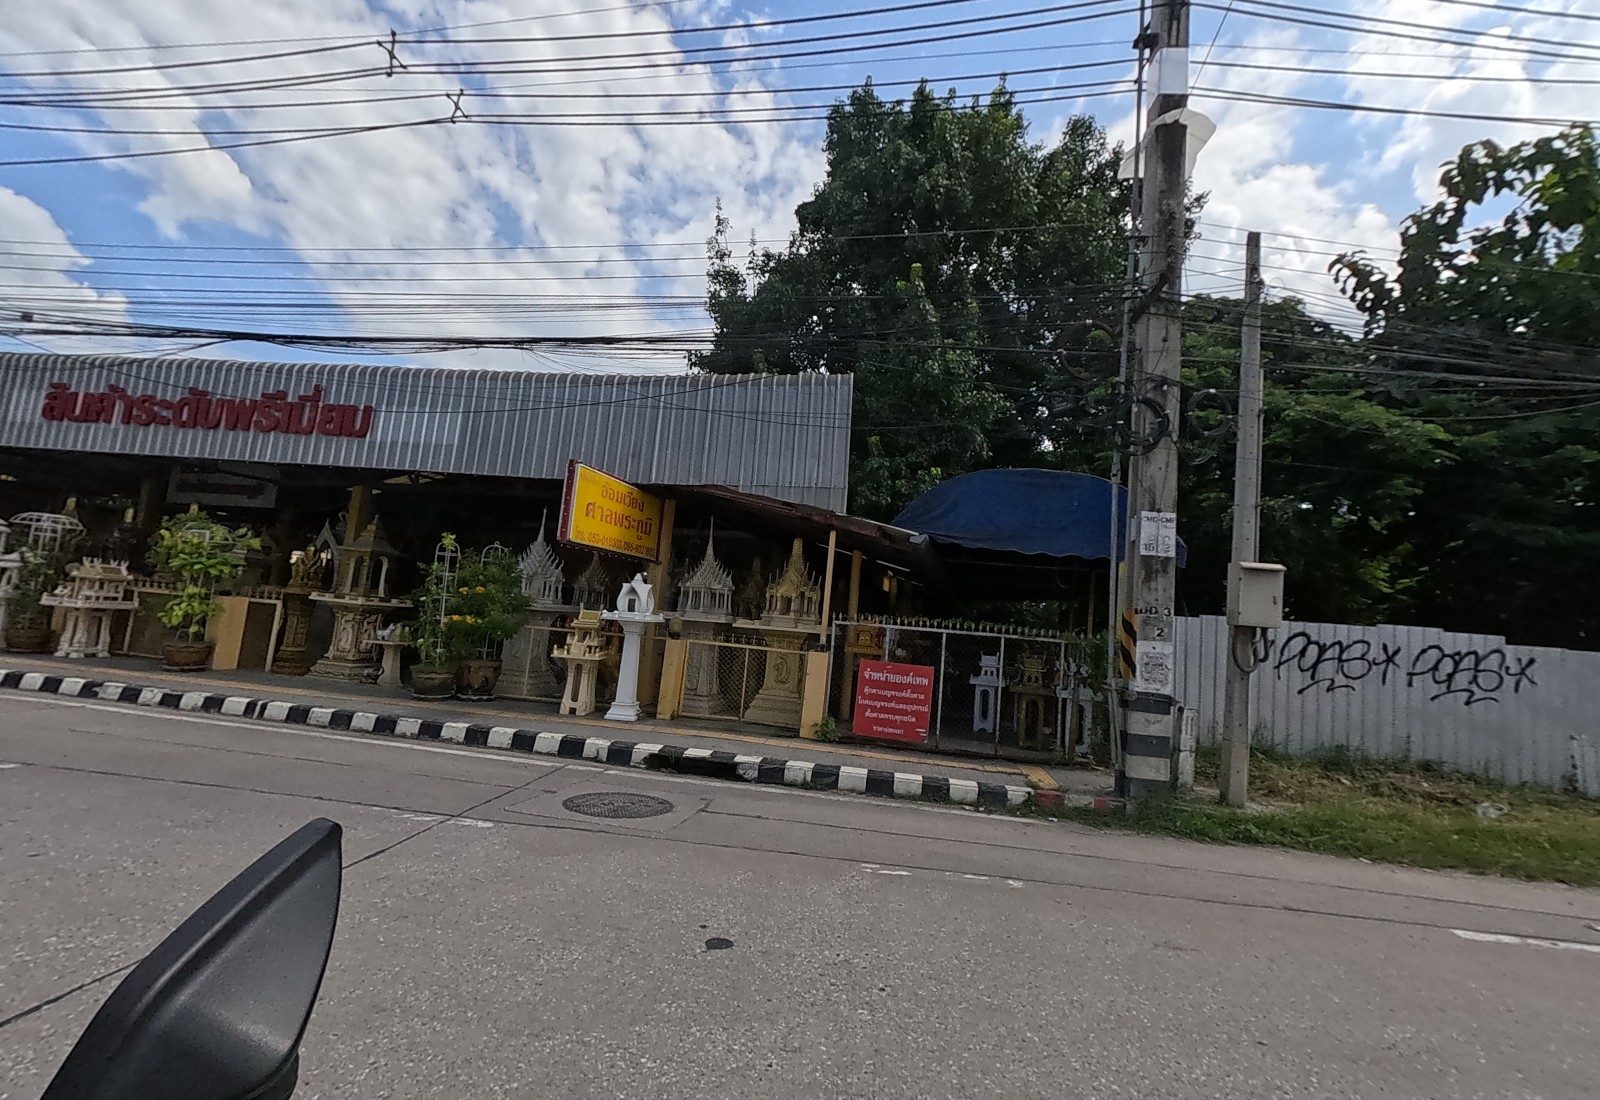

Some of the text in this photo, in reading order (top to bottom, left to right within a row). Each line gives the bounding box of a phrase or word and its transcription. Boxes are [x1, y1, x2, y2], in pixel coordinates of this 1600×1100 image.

[585, 501, 653, 540] ศาลพระภูมิ
[1156, 627, 1165, 638] 2
[863, 668, 929, 685] จำหน่ายองค์เทพ
